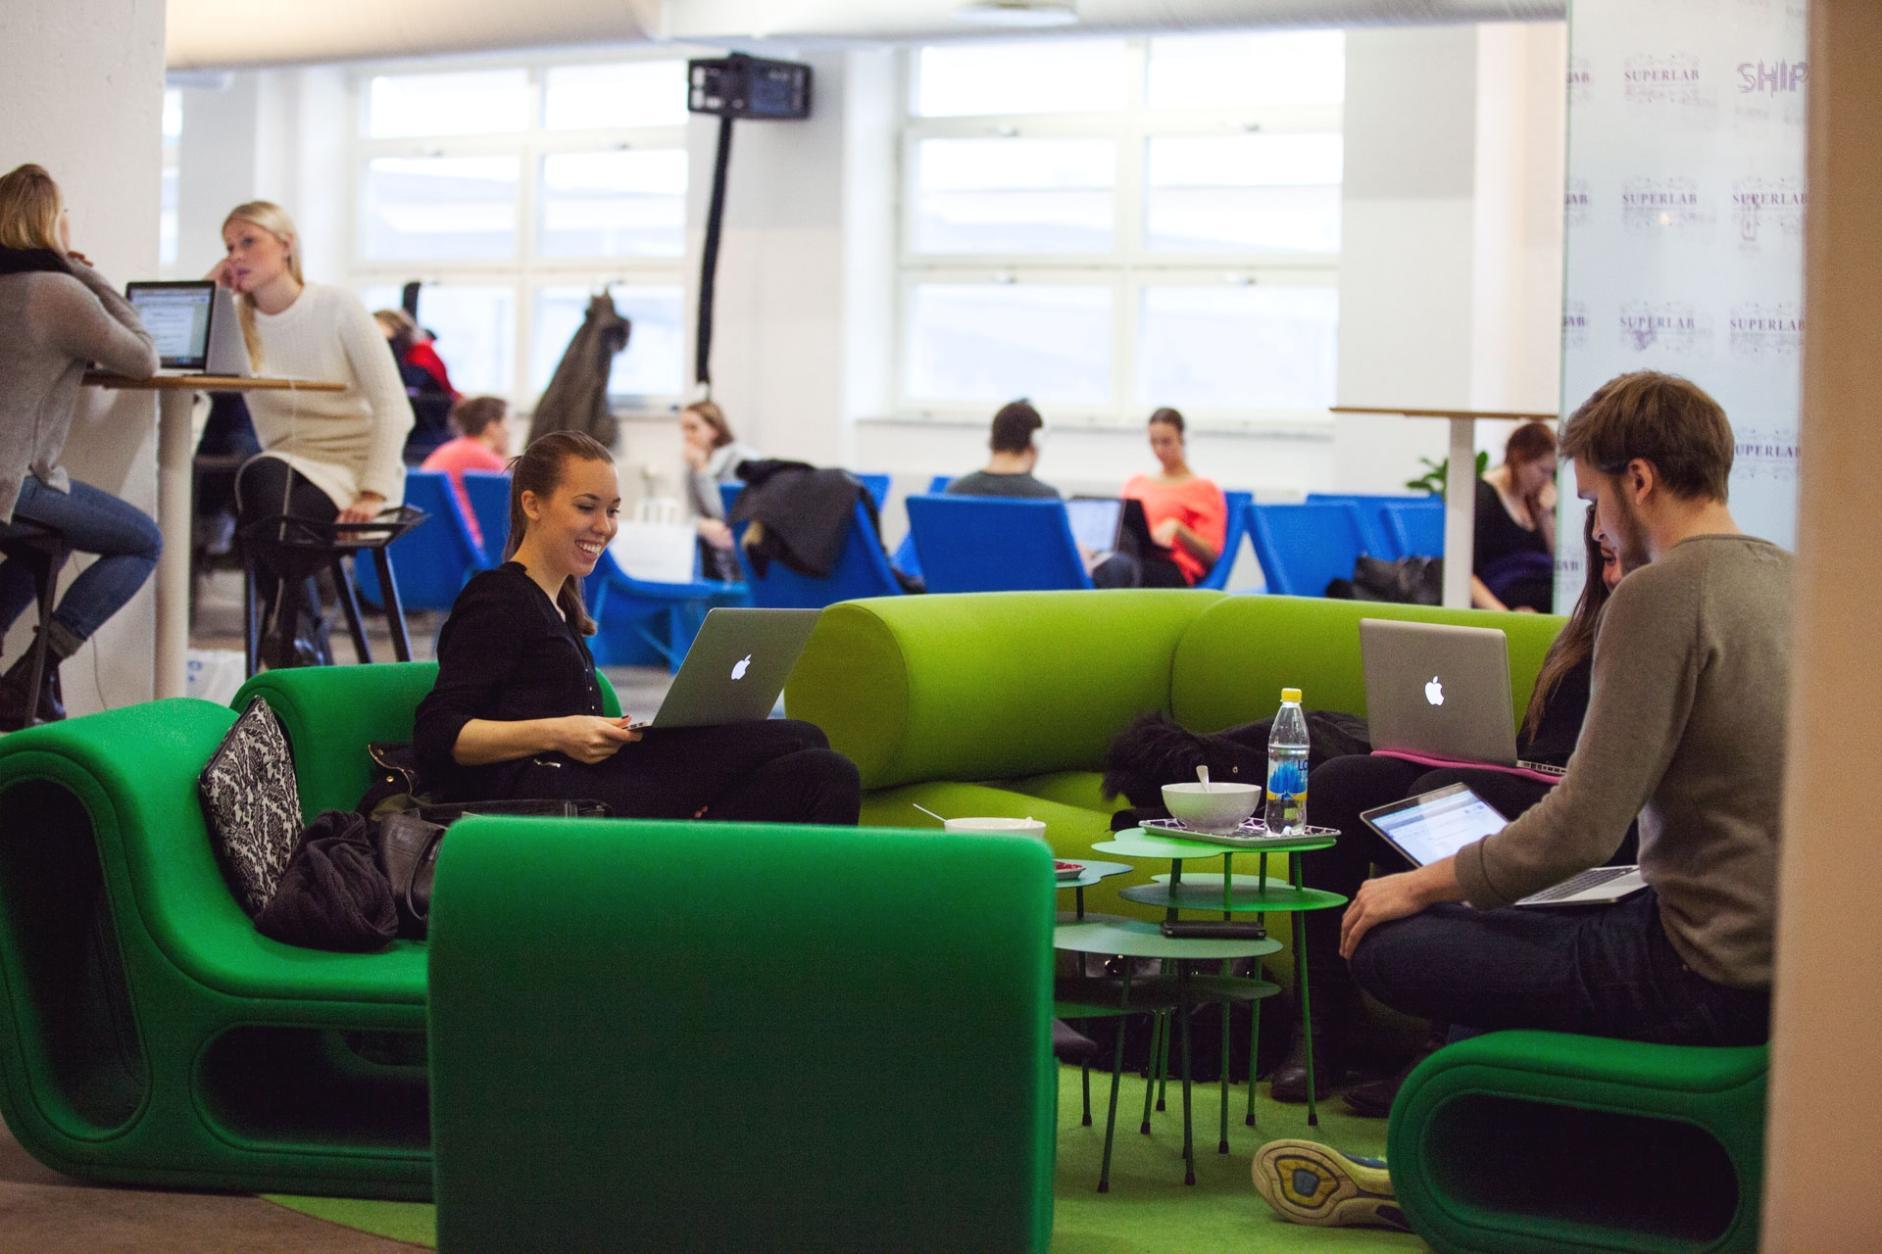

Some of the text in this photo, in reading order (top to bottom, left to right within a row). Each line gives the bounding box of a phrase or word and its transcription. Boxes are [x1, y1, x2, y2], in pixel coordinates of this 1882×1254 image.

[1624, 69, 1700, 81] SUPERLAB
[1622, 193, 1697, 205] SUPERLAB
[1620, 316, 1695, 328] SUPERLAB
[1730, 319, 1805, 331] SUPERLAB
[1735, 444, 1801, 457] UPERLAB
